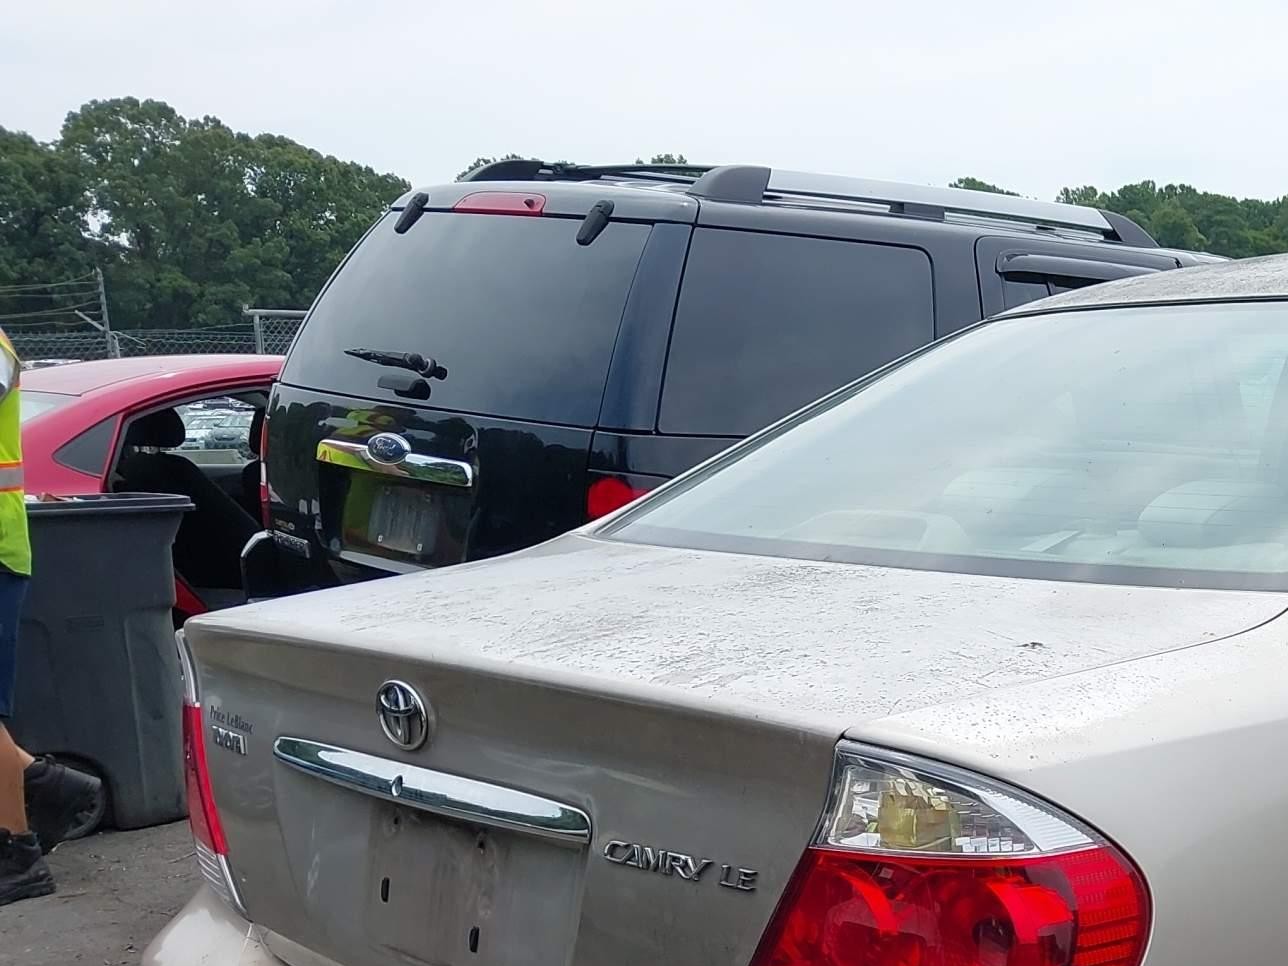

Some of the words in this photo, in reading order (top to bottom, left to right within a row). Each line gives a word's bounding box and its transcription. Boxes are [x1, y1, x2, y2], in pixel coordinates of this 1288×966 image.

[210, 705, 225, 723] Price
[227, 711, 254, 735] LeBlanc
[603, 839, 715, 882] CAMRY
[718, 863, 760, 891] LE
